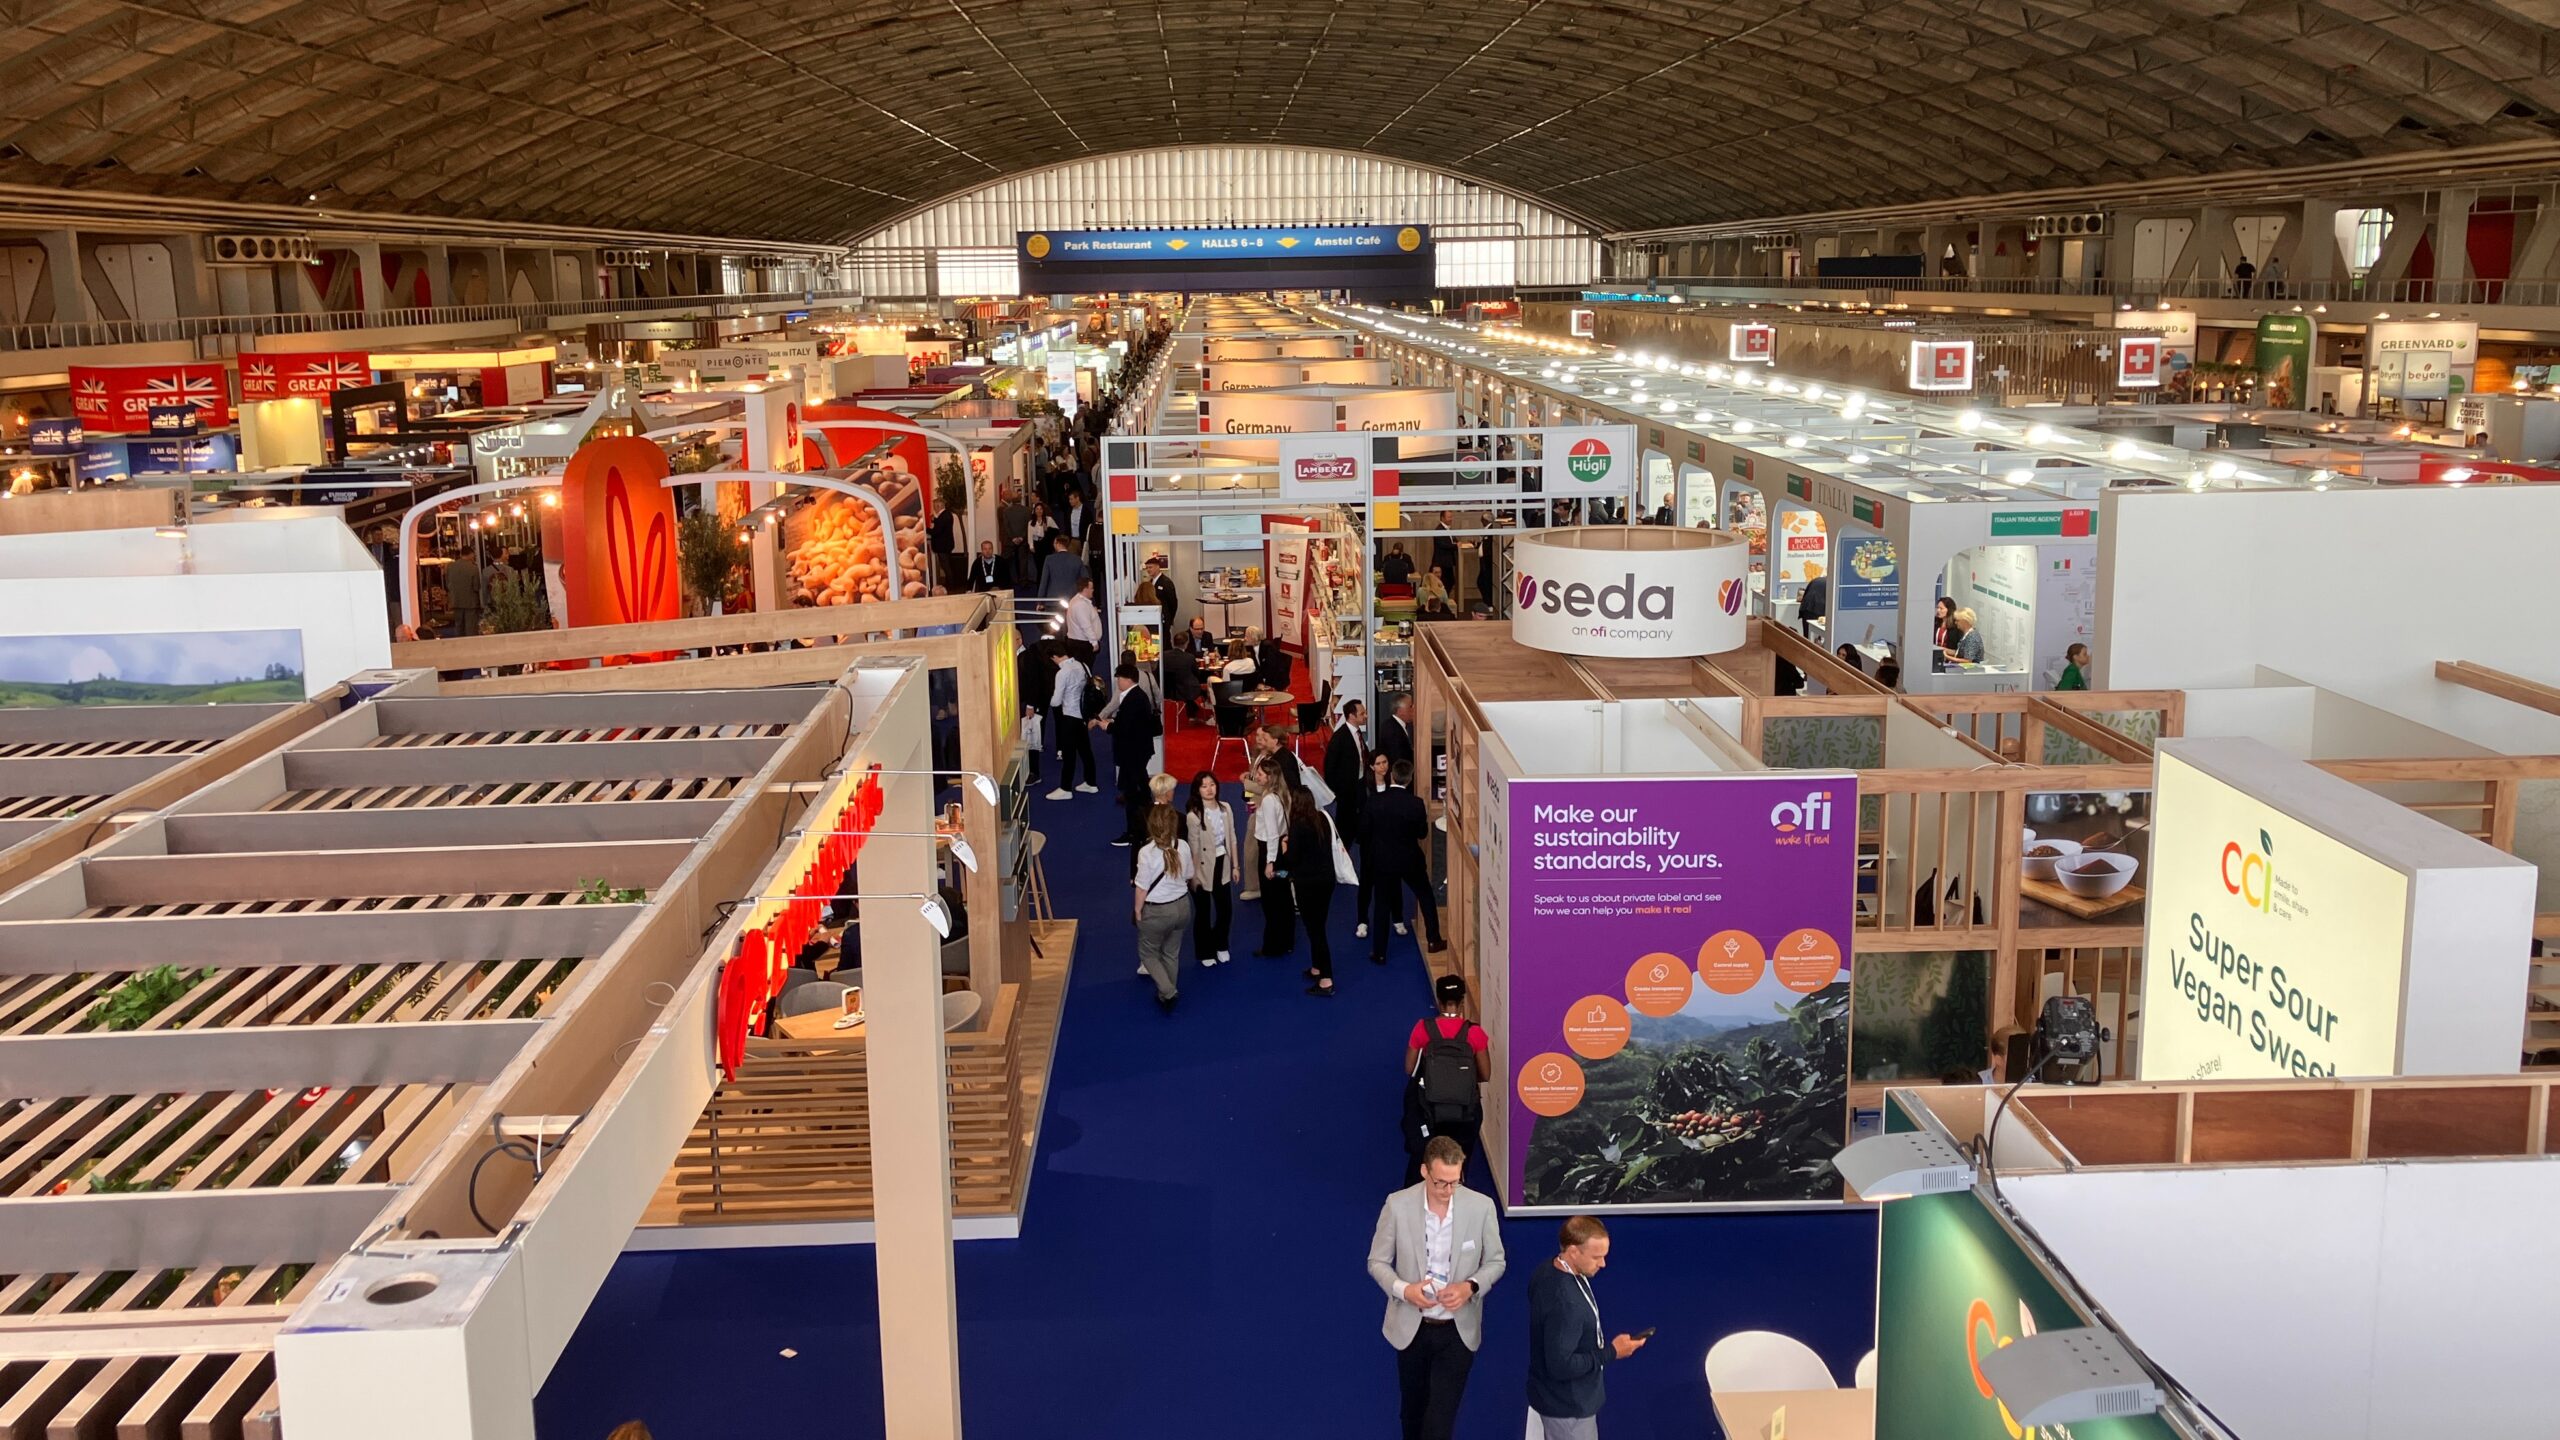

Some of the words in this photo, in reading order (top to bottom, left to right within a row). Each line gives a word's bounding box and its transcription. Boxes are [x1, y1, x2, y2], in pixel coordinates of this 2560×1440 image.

[1064, 241, 1089, 250] Park
[1092, 240, 1152, 250] Restaurant
[1202, 239, 1238, 248] HALLS
[1315, 237, 1352, 246] Amstel
[1356, 236, 1381, 246] Café
[2381, 339, 2454, 349] GREENYARD
[789, 348, 811, 356] ITALY
[681, 359, 697, 368] ITALY
[707, 355, 763, 368] PIEMONTE
[2408, 370, 2446, 381] beyers
[243, 379, 263, 391] GREAT
[288, 379, 332, 391] GREAT
[76, 397, 98, 411] GREAT
[2461, 402, 2484, 410] TAKING
[2460, 409, 2484, 418] COFFEE
[1225, 418, 1292, 434] Germany
[1362, 419, 1421, 432] Germany
[2457, 417, 2486, 427] FURTHER
[1298, 462, 1353, 478] LAMBERTZ
[1572, 459, 1607, 475] Hügli
[1818, 482, 1848, 514] ITALIA
[1541, 573, 1674, 620] seda
[1572, 626, 1588, 636] an
[1590, 626, 1607, 637] ofi
[1609, 629, 1673, 642] company
[1534, 804, 1594, 824] Make
[1600, 808, 1637, 823] our
[1770, 791, 1832, 832] ofi
[1534, 826, 1680, 849] sustainability
[1775, 835, 1801, 845] make
[1813, 834, 1830, 845] real
[1533, 852, 1652, 872] standards,
[1658, 853, 1723, 873] yours.
[2274, 874, 2291, 892] Made
[2292, 884, 2299, 895] to
[1534, 894, 1564, 904] Speak
[1591, 894, 1620, 902] about
[1623, 894, 1656, 904] private
[1657, 893, 1681, 902] label
[1683, 893, 1703, 902] and
[1704, 894, 1722, 902] see
[1534, 907, 1554, 916] how
[1592, 905, 1614, 917] help
[1615, 908, 1633, 917] you
[1635, 905, 1661, 914] make
[1663, 905, 1671, 914] it
[1672, 905, 1692, 914] real
[2291, 899, 2309, 917] share
[2189, 912, 2263, 991] Super
[2269, 965, 2339, 1043] Sour
[2171, 948, 2242, 1037] Vegan
[2196, 1054, 2222, 1078] share!
